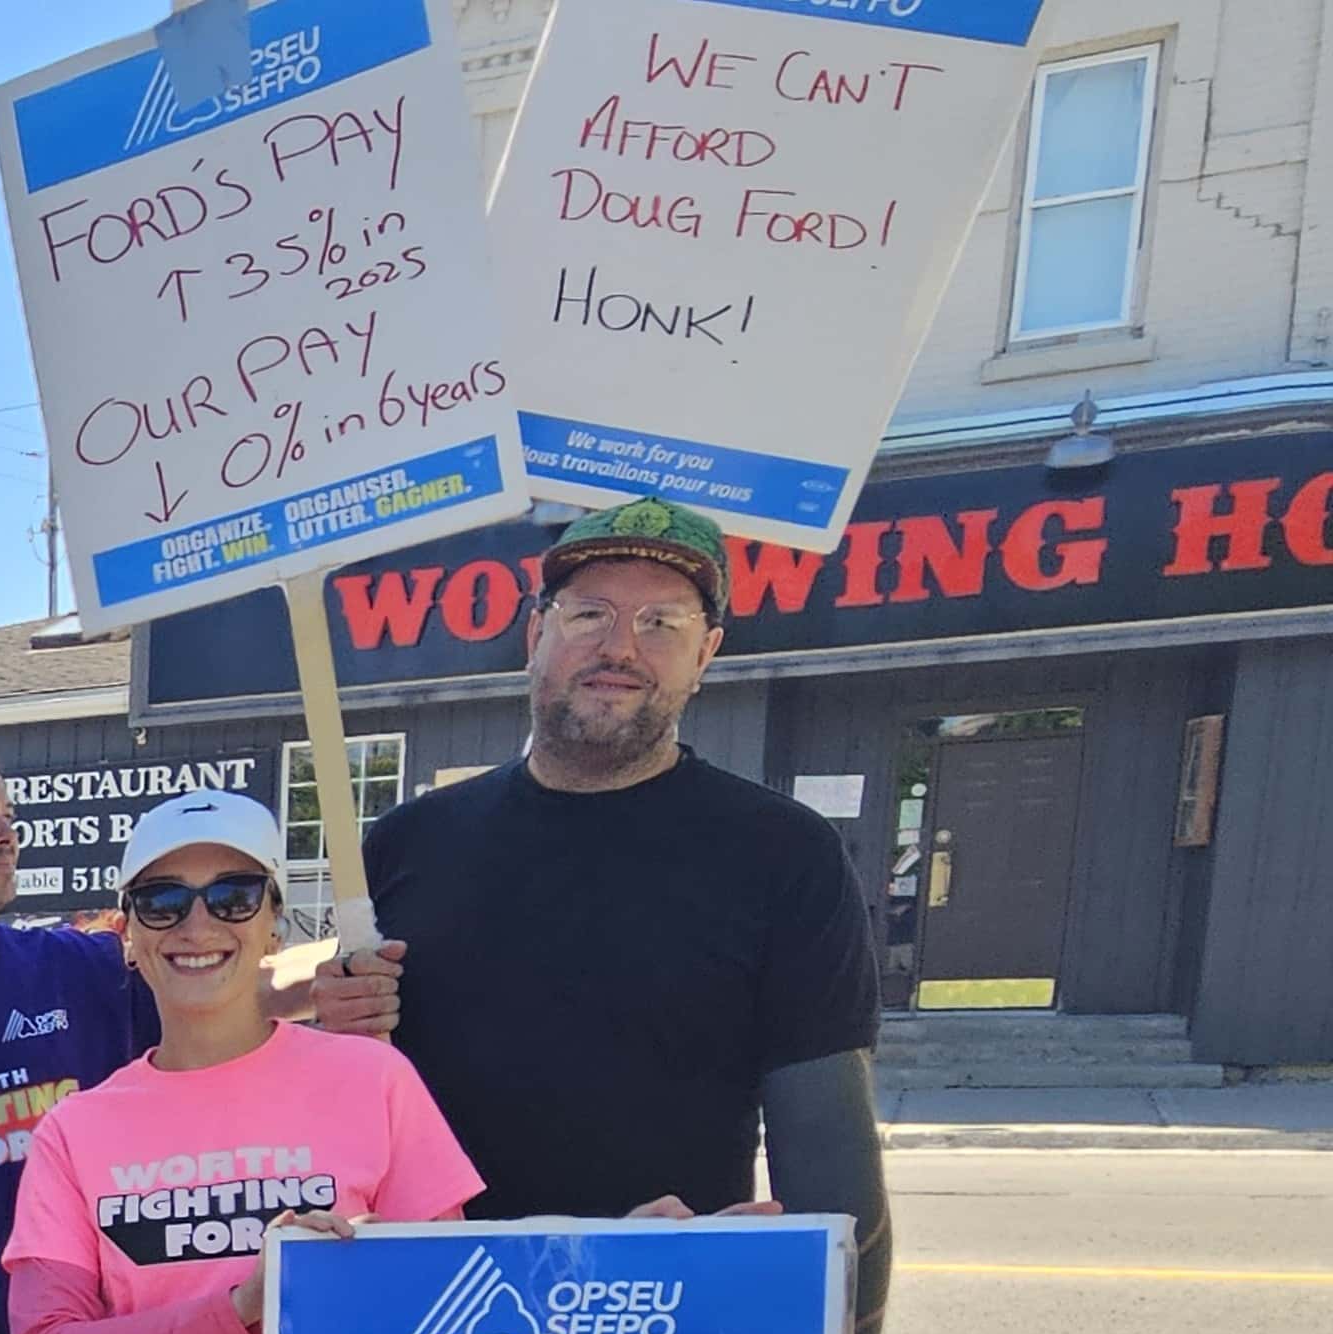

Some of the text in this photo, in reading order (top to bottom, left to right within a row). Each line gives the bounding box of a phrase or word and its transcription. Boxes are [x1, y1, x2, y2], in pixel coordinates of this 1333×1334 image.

[249, 25, 321, 74] PSEU
[646, 32, 944, 110] WE CAN'T
[223, 55, 322, 113] SEFPO
[579, 95, 776, 167] AFFORD
[39, 96, 405, 281] FORD'S PAY
[551, 168, 896, 269] DOUG FORD!
[226, 208, 405, 299] 35% in
[326, 247, 425, 300] 2025
[552, 265, 754, 364] HONK!
[76, 311, 375, 465] OUR PAY
[221, 402, 304, 488] 0%
[324, 412, 364, 443] in
[566, 430, 714, 473] We work for you
[284, 469, 415, 522] ORGANISER.
[523, 446, 752, 502] ous travaillons pour vous
[162, 513, 272, 557] ORGANIZE.
[287, 474, 472, 544] LUTTER. GAGNER.
[153, 533, 274, 584] FIGHT. WIN.
[332, 556, 543, 650] WO
[726, 496, 1108, 617] WING
[6, 758, 255, 804] RESTAURANT
[12, 815, 100, 848] ORTS
[110, 1146, 312, 1191] WORTH
[99, 1174, 335, 1226] FIGHTING
[164, 1220, 264, 1258] FOR
[547, 1281, 683, 1312] OPSEU
